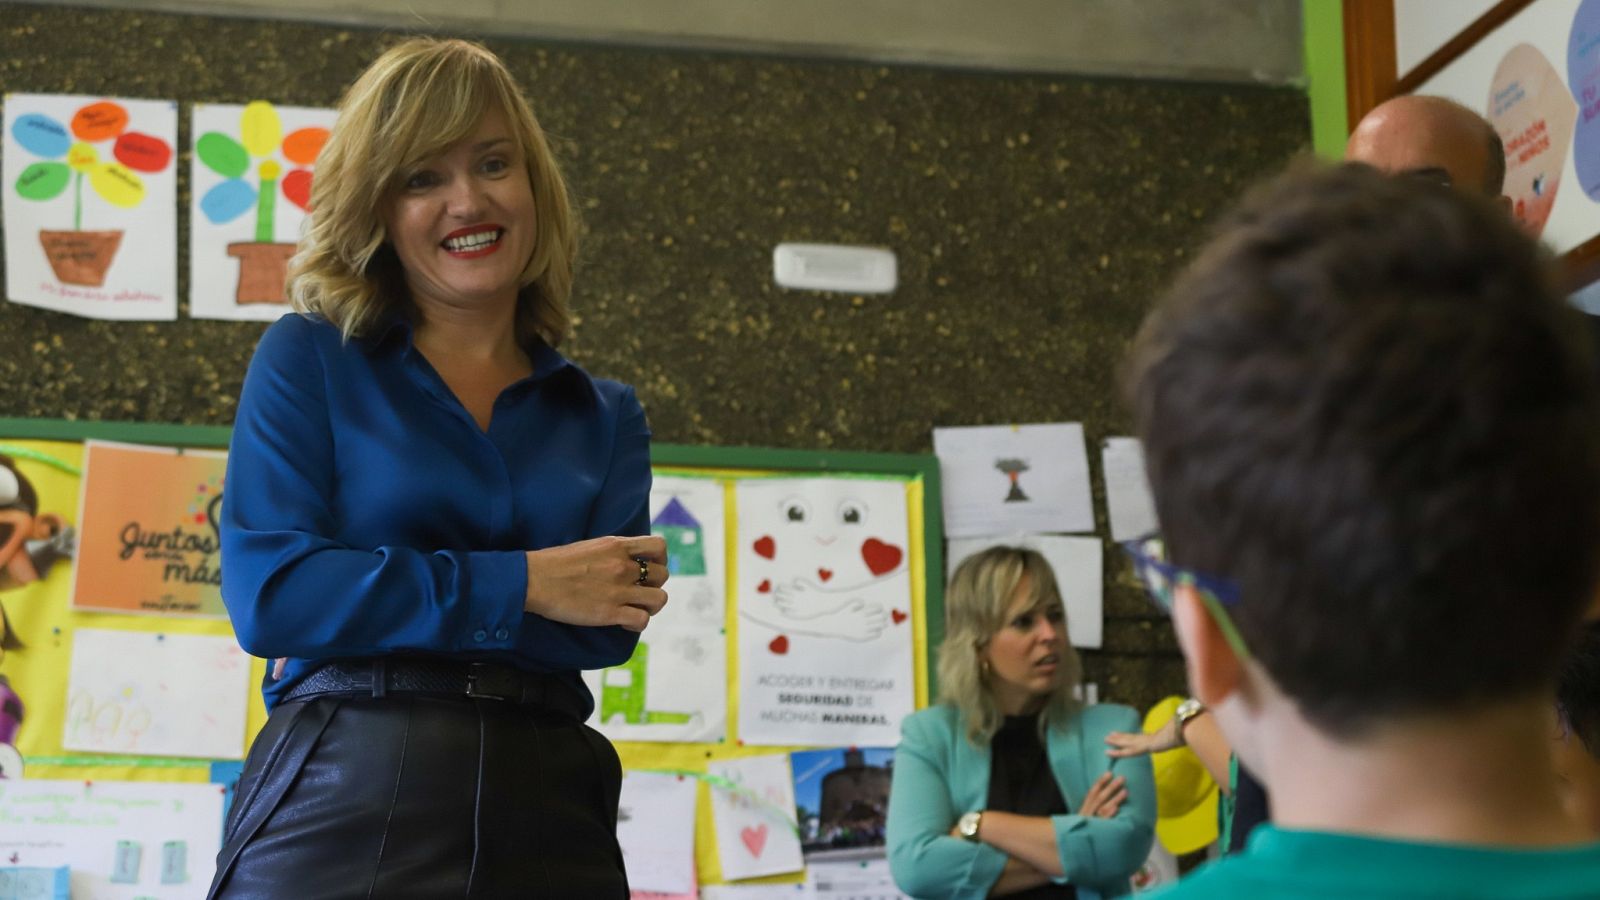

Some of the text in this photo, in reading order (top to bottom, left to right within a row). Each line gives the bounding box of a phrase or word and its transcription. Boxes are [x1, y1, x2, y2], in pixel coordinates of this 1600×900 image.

[120, 522, 213, 560] Juntos
[759, 674, 895, 691] ACOGER Y ENTREGAR
[778, 693, 873, 707] SEGURIDAD DE
[761, 710, 818, 725] MUCHAS
